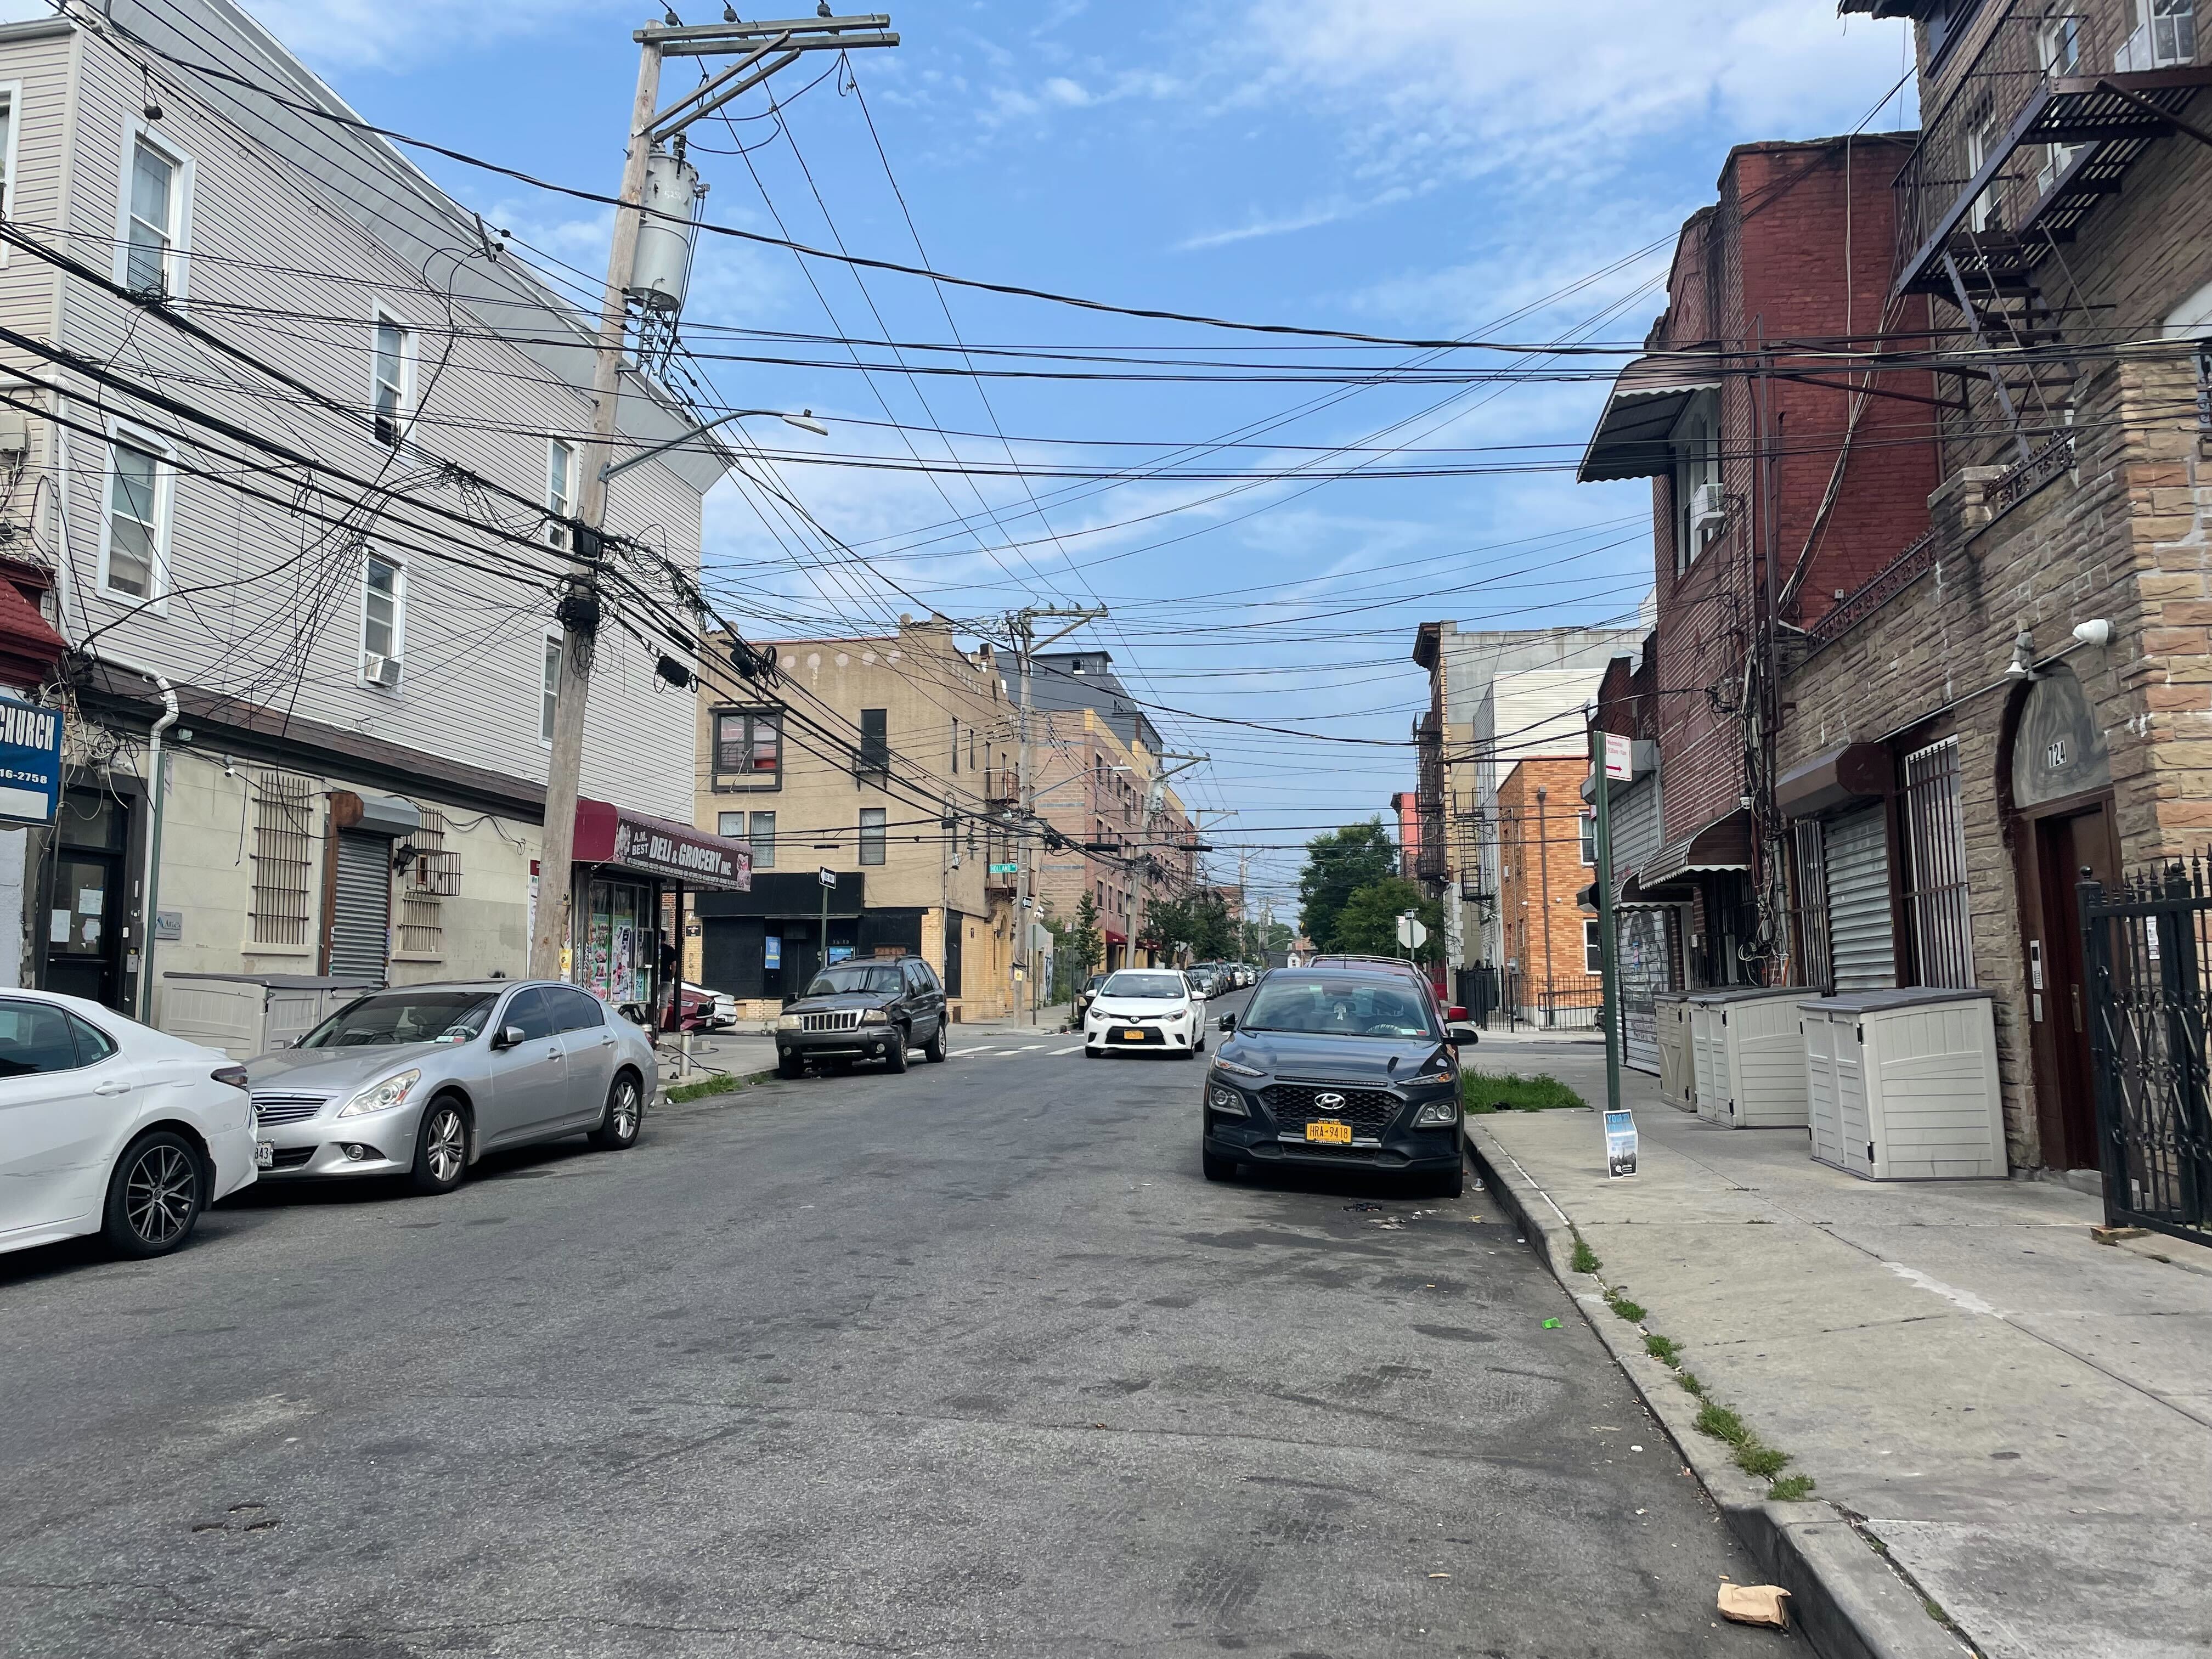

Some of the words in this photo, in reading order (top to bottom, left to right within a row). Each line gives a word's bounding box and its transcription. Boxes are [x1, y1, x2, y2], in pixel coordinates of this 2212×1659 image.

[2049, 741, 2066, 766] 724
[634, 831, 647, 843] A.M.
[632, 843, 648, 855] BEST
[649, 835, 673, 862] DELI
[672, 850, 678, 865] &
[679, 843, 722, 873] GROCERY
[720, 861, 731, 876] INC.
